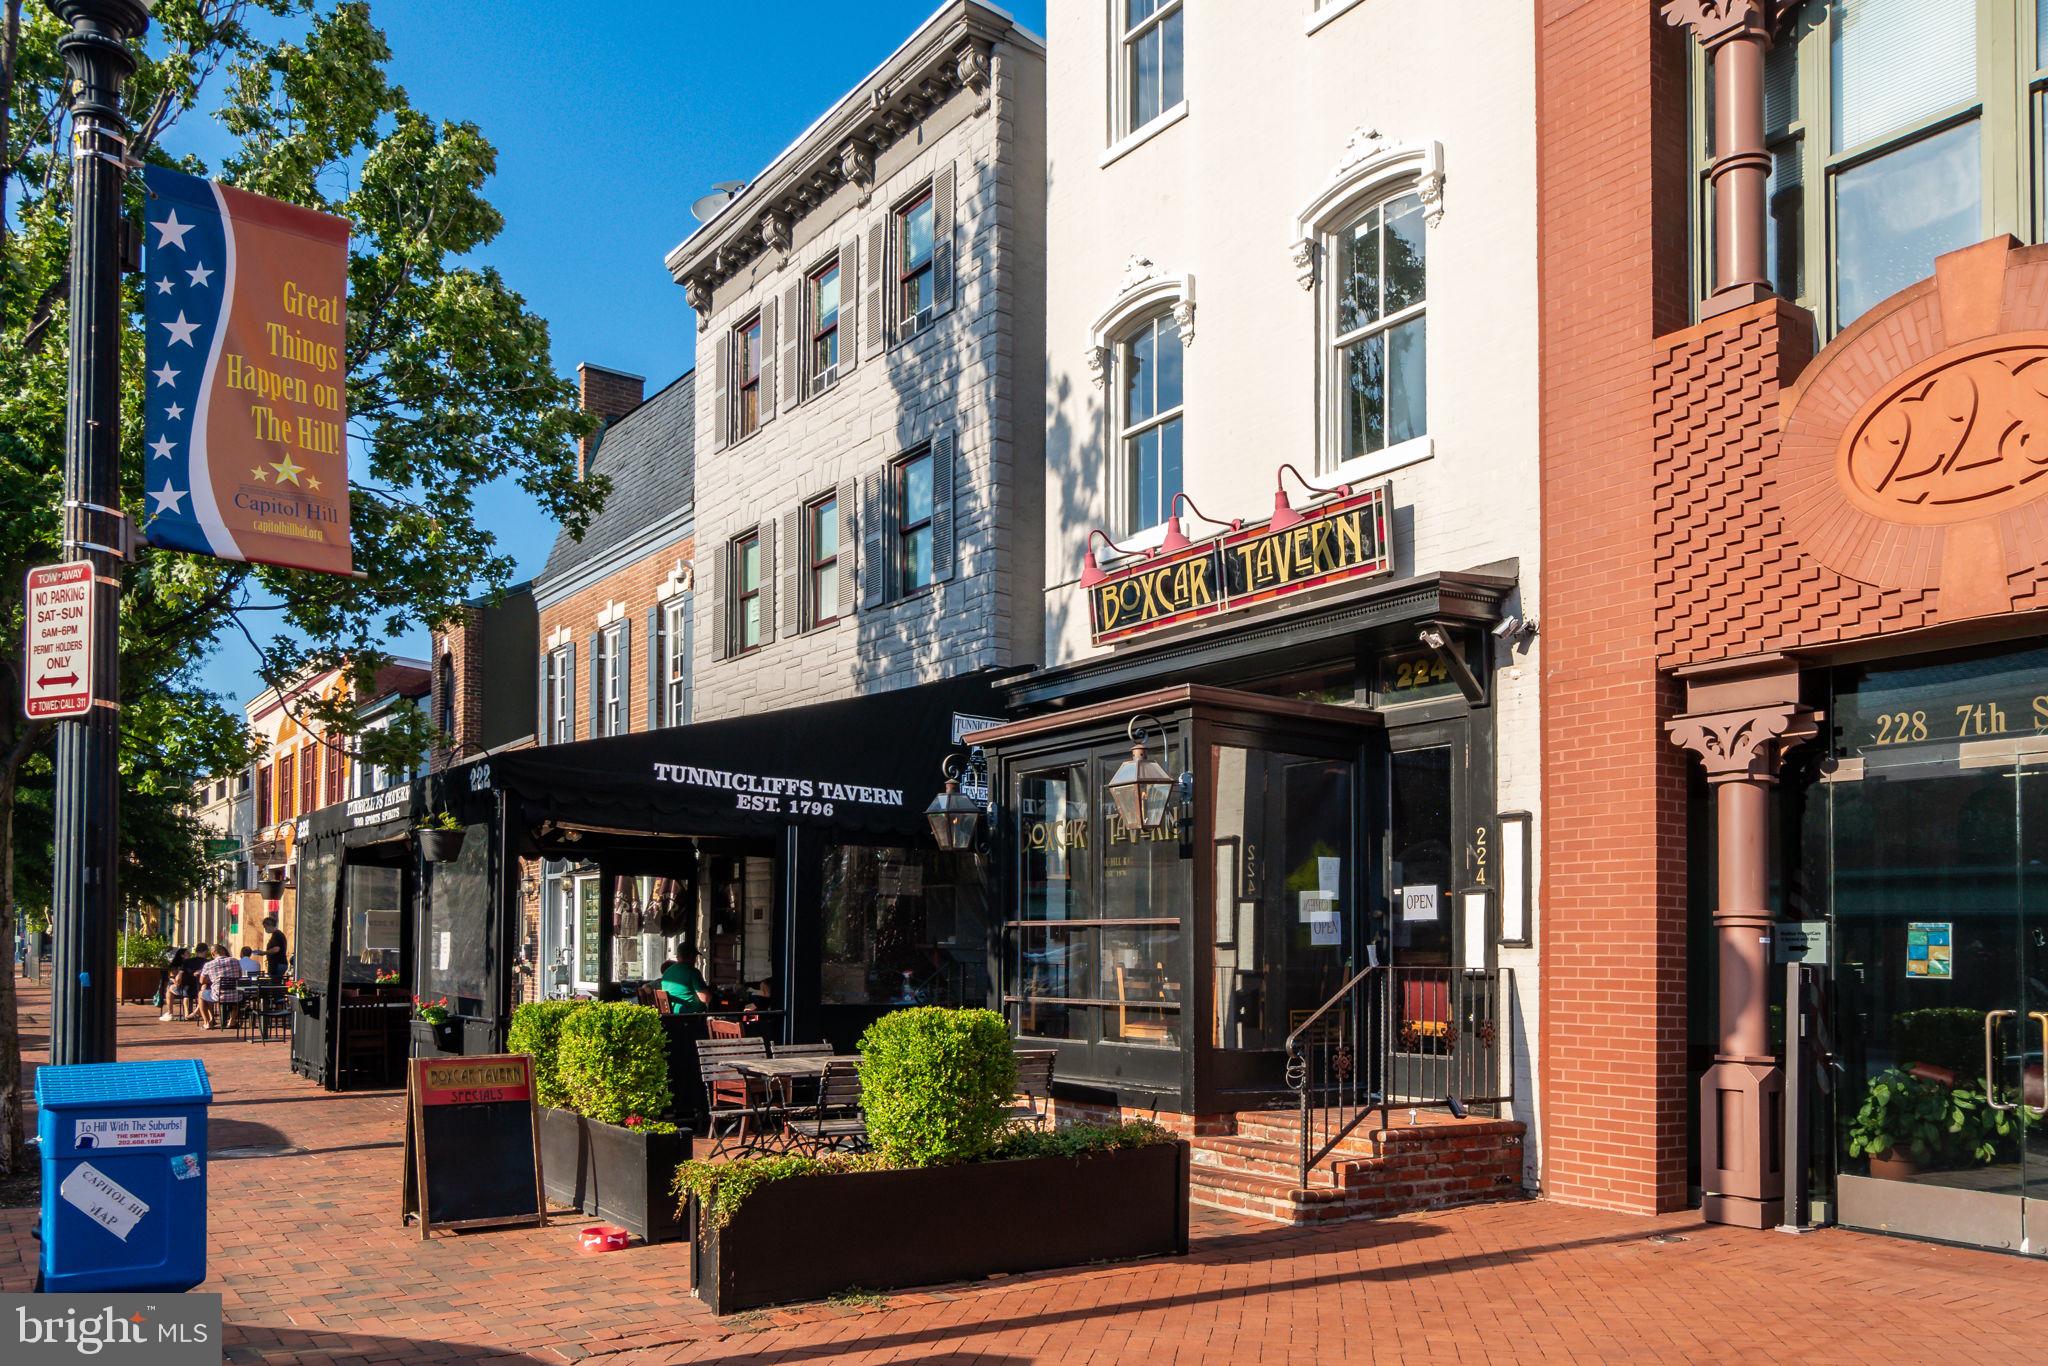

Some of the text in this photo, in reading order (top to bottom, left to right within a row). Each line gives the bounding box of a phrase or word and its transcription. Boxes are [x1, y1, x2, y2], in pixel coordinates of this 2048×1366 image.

[283, 280, 339, 326] Great
[266, 321, 338, 373] Things
[226, 353, 339, 412] Happen on
[251, 405, 340, 456] The Hill!
[234, 493, 300, 517] Capitol
[306, 503, 338, 524] Hill
[253, 520, 323, 542] capitolhillbid.org
[1101, 510, 1363, 630] BOXCAR TAVERN
[36, 586, 85, 607] NO PARKING
[37, 606, 83, 623] SAT-SUN
[41, 624, 78, 639] 6AM-6PM
[33, 640, 83, 655] PERMIT HOLDERS
[46, 655, 72, 670] ONLY
[1396, 656, 1448, 689] 224
[31, 702, 37, 713] IF
[60, 698, 75, 711] CALL
[76, 697, 87, 709] 311
[1876, 710, 1928, 745] 228
[1955, 702, 2008, 737] 7th
[470, 764, 491, 792] 222
[653, 762, 904, 806] TUNNICLIFFS TAVERN
[736, 793, 834, 817] EST. 1796
[1476, 827, 1487, 885] 224
[1406, 893, 1434, 910] OPEN
[476, 1066, 521, 1084] TAVERN
[451, 1089, 504, 1103] SPECIALS
[81, 1119, 183, 1133] To Hill With The Suburbs!
[82, 1170, 127, 1206] CAPITOL
